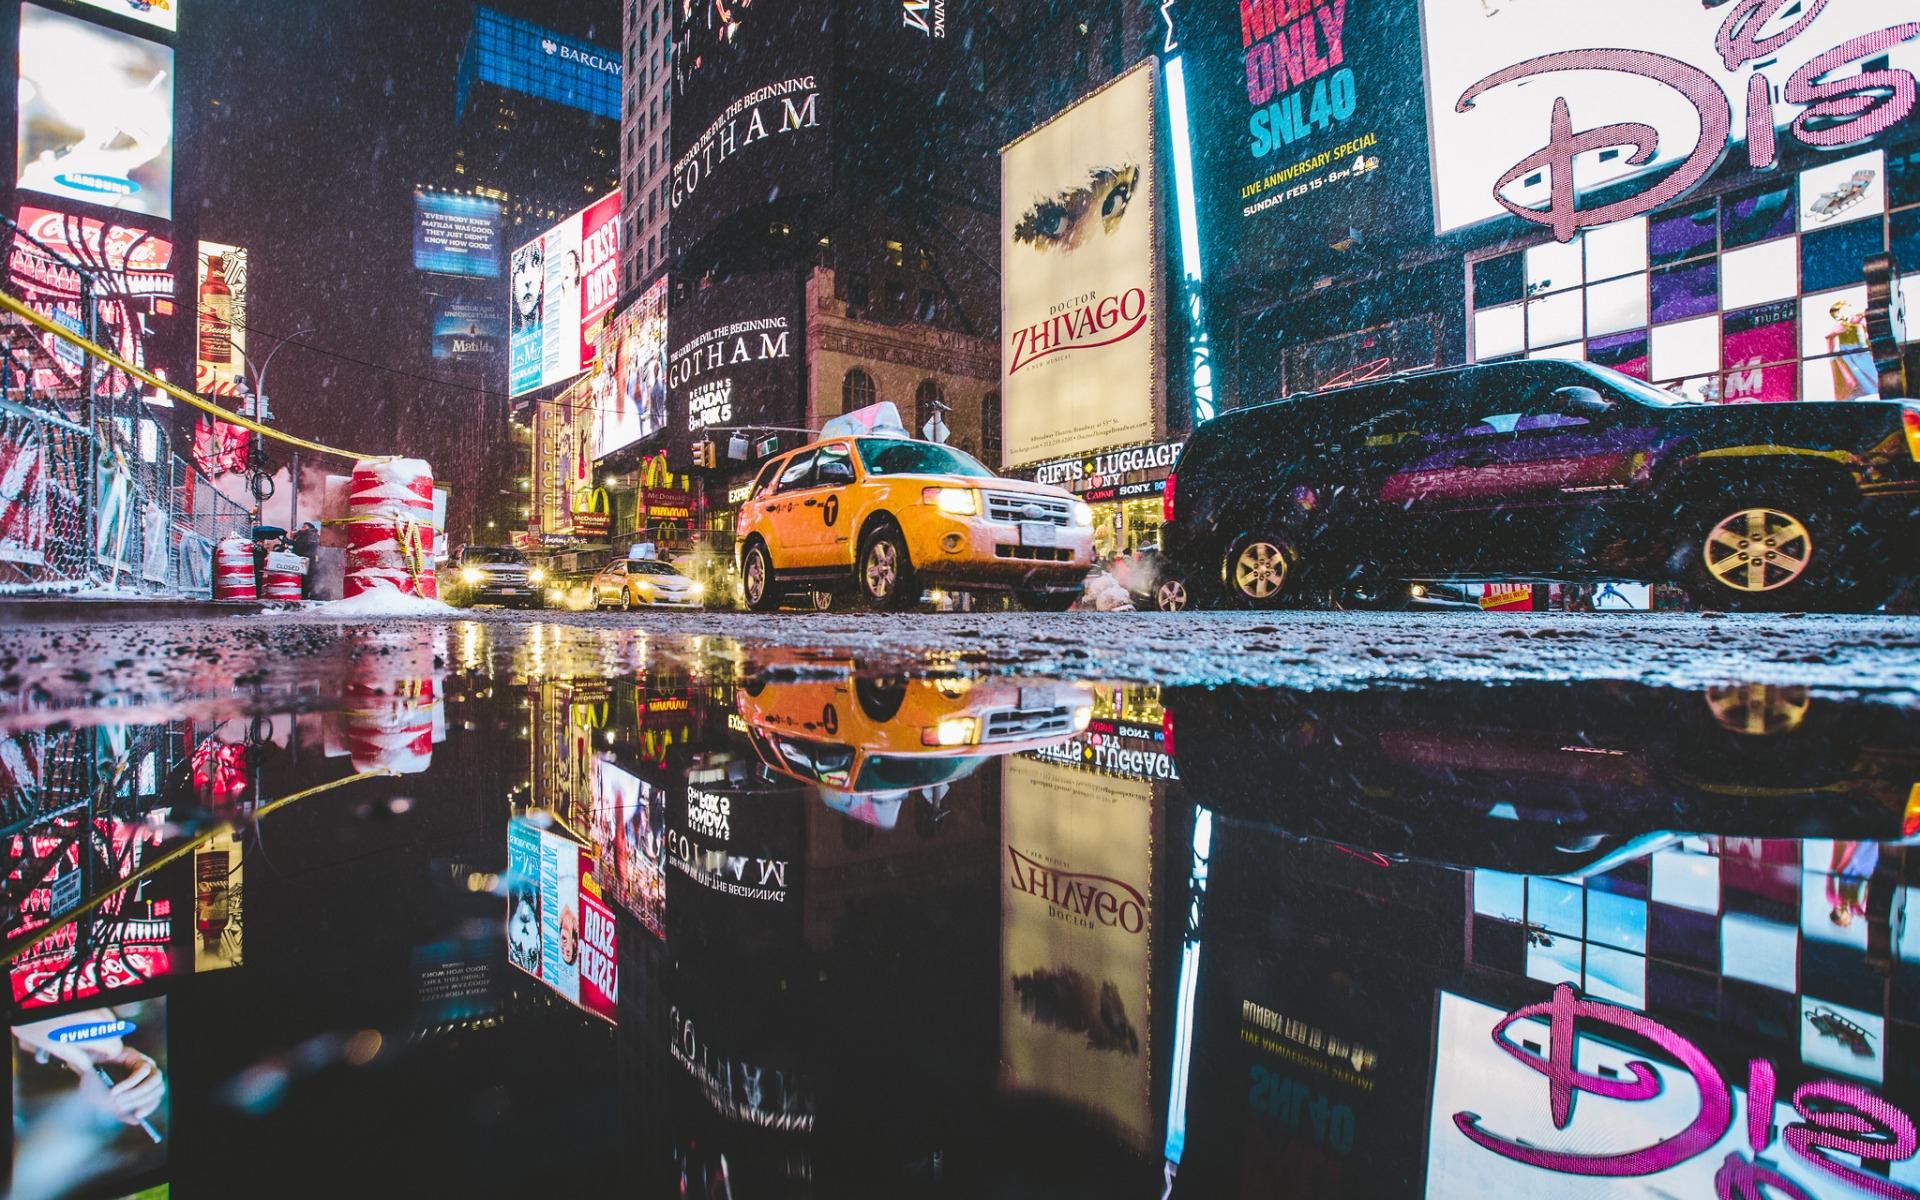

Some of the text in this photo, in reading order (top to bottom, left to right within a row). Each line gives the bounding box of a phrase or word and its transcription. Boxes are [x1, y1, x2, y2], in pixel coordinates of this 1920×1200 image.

[1245, 0, 1345, 106] ONLY
[725, 99, 743, 120] THE
[743, 76, 817, 109] BEGINNING.
[672, 93, 820, 209] GOTHAM
[1242, 181, 1262, 198] LIVE
[1263, 150, 1331, 189] ANNIVERSARY
[1333, 132, 1378, 160] SPECIAL
[1243, 193, 1285, 217] SUNDAY
[1286, 184, 1308, 200] FEB
[1309, 178, 1323, 191] 15
[1328, 169, 1350, 183] 8PM
[422, 220, 453, 230] MATILDA
[425, 229, 445, 237] THEY
[469, 218, 491, 226] KNEW
[424, 237, 448, 245] KNOW
[449, 239, 467, 247] HOW
[581, 213, 621, 277] JERSEY
[587, 258, 619, 312] BOYS
[1049, 290, 1097, 315] DOCTOR
[713, 325, 729, 339] THE
[730, 317, 788, 335] BEGINNING.
[1009, 287, 1147, 375] ZHIVAGO
[669, 331, 790, 389] GOTHAM
[689, 378, 732, 400] RETURNS
[689, 388, 732, 415] MONDAY
[720, 404, 732, 422] 5
[543, 410, 554, 505] PALACE
[1036, 459, 1083, 485] GIFTS
[1102, 473, 1122, 488] NY
[1119, 483, 1150, 496] SONY
[276, 563, 300, 571] CLOSED
